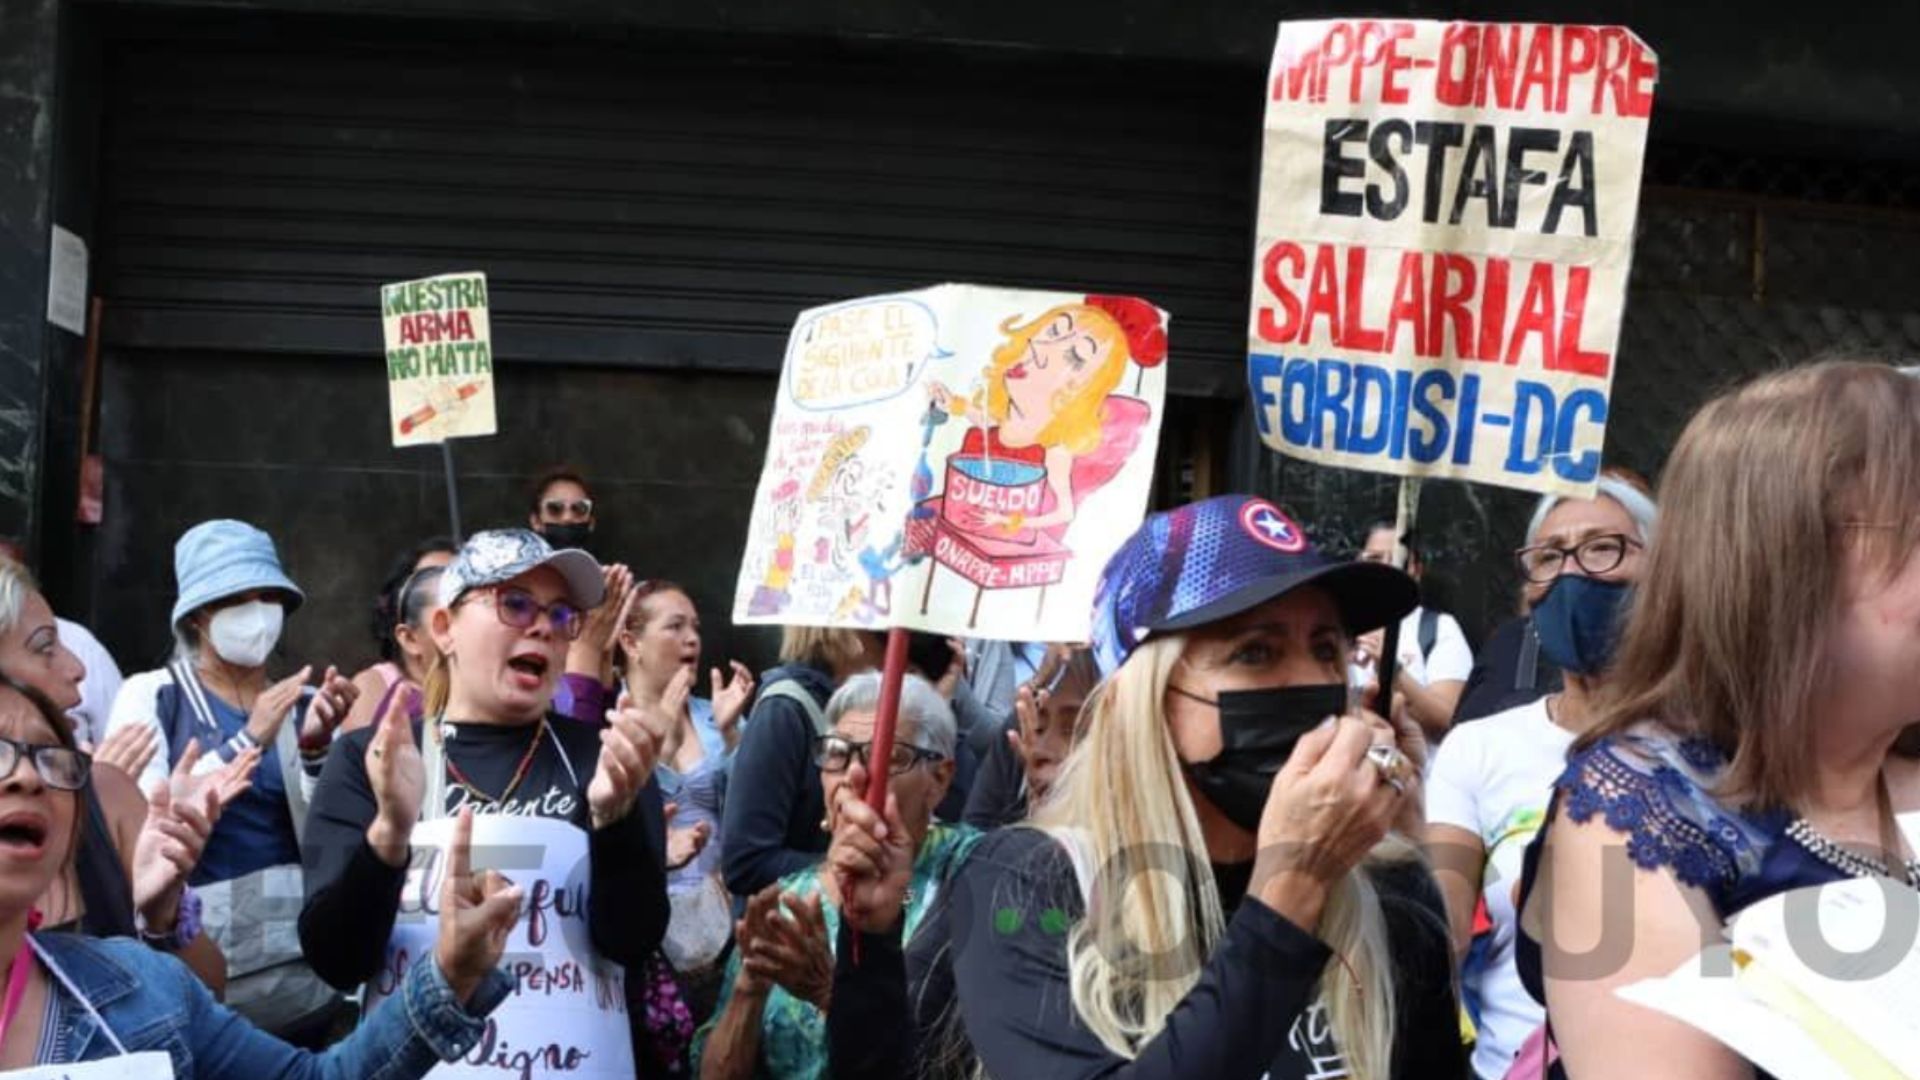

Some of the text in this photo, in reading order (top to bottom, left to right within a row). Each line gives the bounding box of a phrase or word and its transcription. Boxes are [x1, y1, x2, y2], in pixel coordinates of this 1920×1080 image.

[1272, 21, 1659, 118] MPPE-ONAPRE
[1319, 118, 1598, 237] ESTAFA
[385, 277, 487, 316] NUESTRA
[400, 310, 475, 344] ARMA
[1257, 240, 1610, 378] SALARIAL
[387, 341, 491, 381] NO MATA
[1249, 353, 1608, 483] FORDISI-DC
[951, 475, 1040, 511] SUELDO
